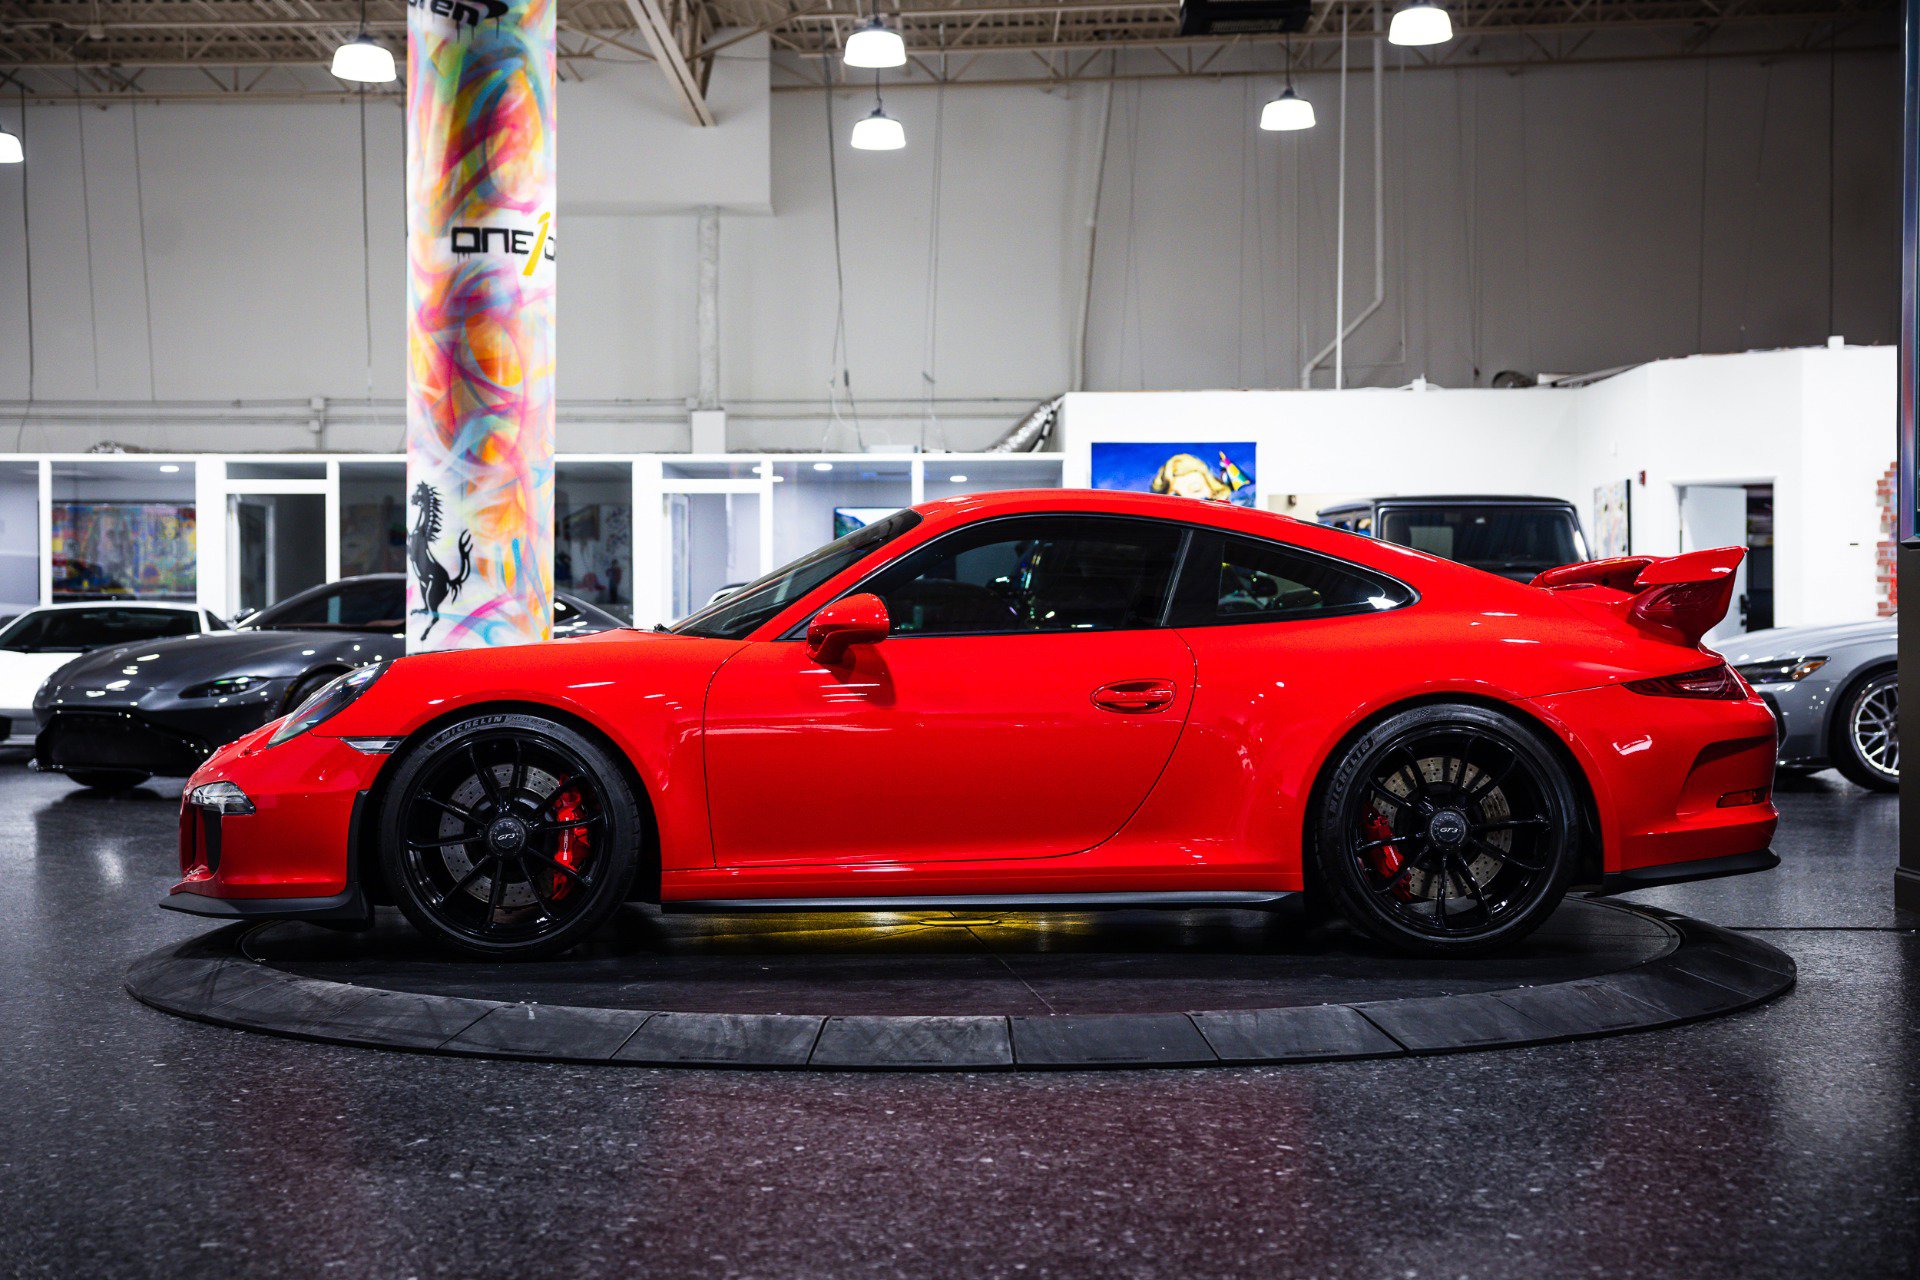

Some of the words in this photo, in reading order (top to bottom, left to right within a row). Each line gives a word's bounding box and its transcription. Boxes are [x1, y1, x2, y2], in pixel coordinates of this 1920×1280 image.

[441, 715, 502, 740] MICHELIN
[1329, 738, 1371, 814] MICHELIN
[497, 833, 515, 841] GT3
